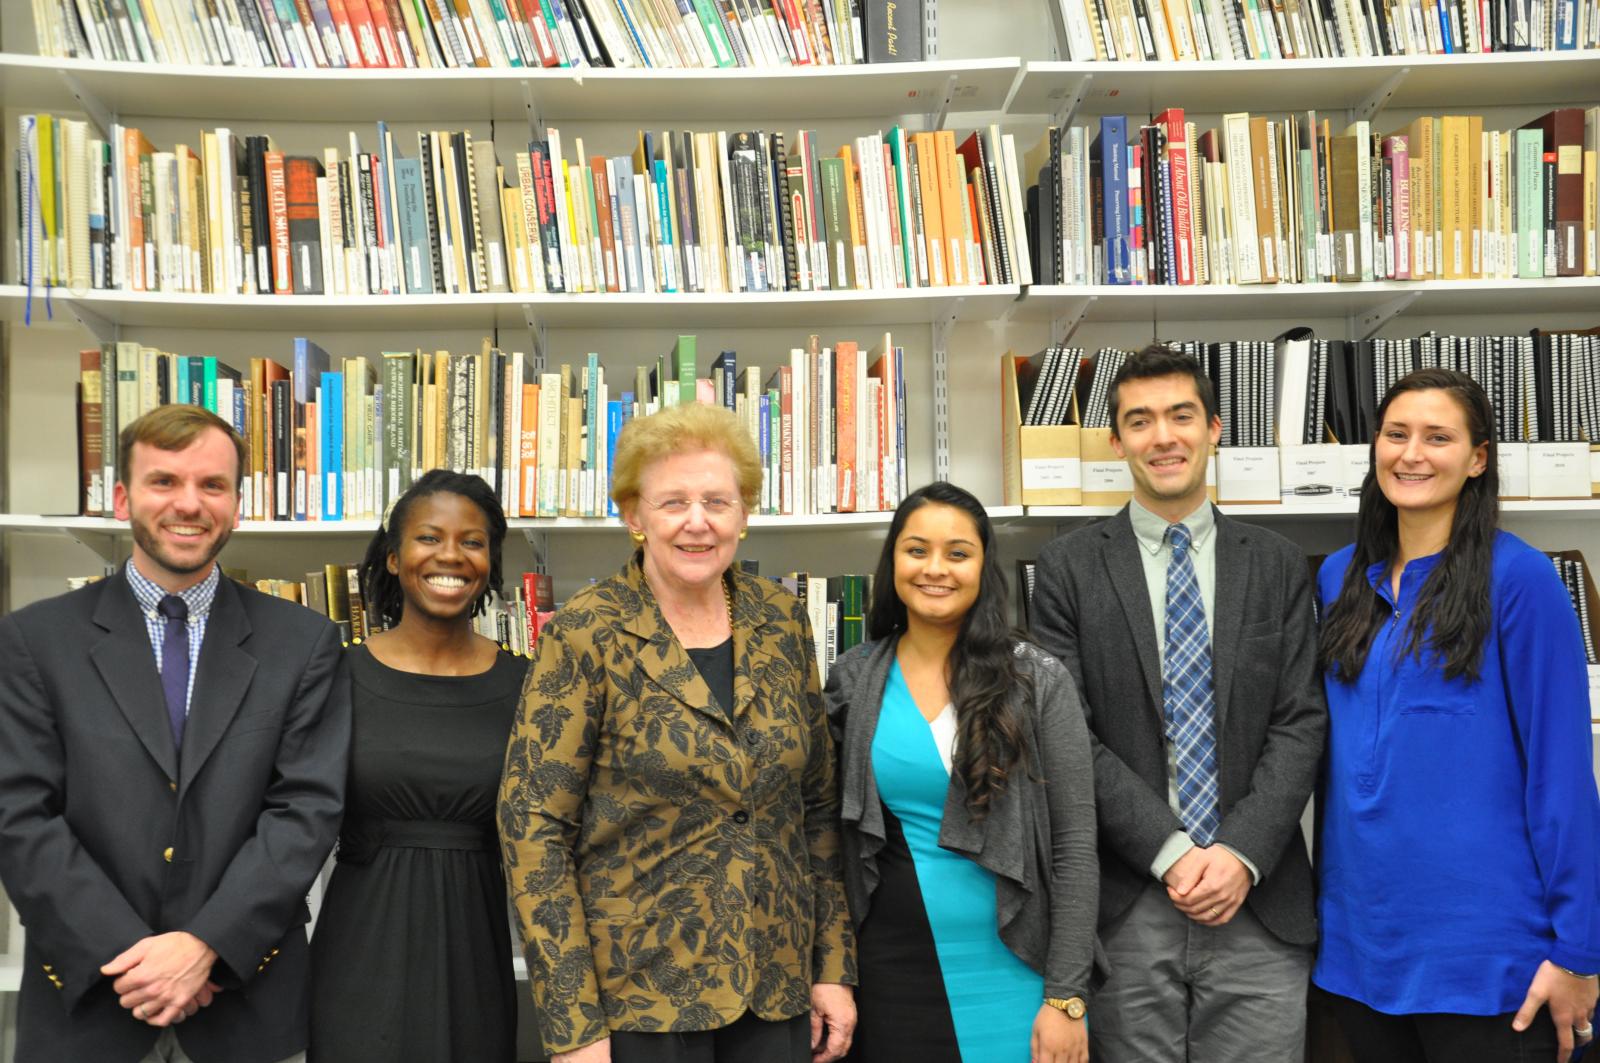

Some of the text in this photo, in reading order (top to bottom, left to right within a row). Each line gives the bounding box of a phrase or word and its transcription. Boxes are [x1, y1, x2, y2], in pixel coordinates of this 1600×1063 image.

[756, 151, 764, 178] AMERICAN
[1174, 153, 1184, 166] All
[1532, 142, 1540, 191] Common Places
[271, 168, 285, 190] THE
[520, 166, 533, 197] URBAN
[1175, 166, 1186, 190] About
[1385, 169, 1393, 206] ARCHITECTURE
[273, 190, 286, 216] CITY
[327, 162, 341, 239] MAIN STREET
[1177, 190, 1188, 207] Old
